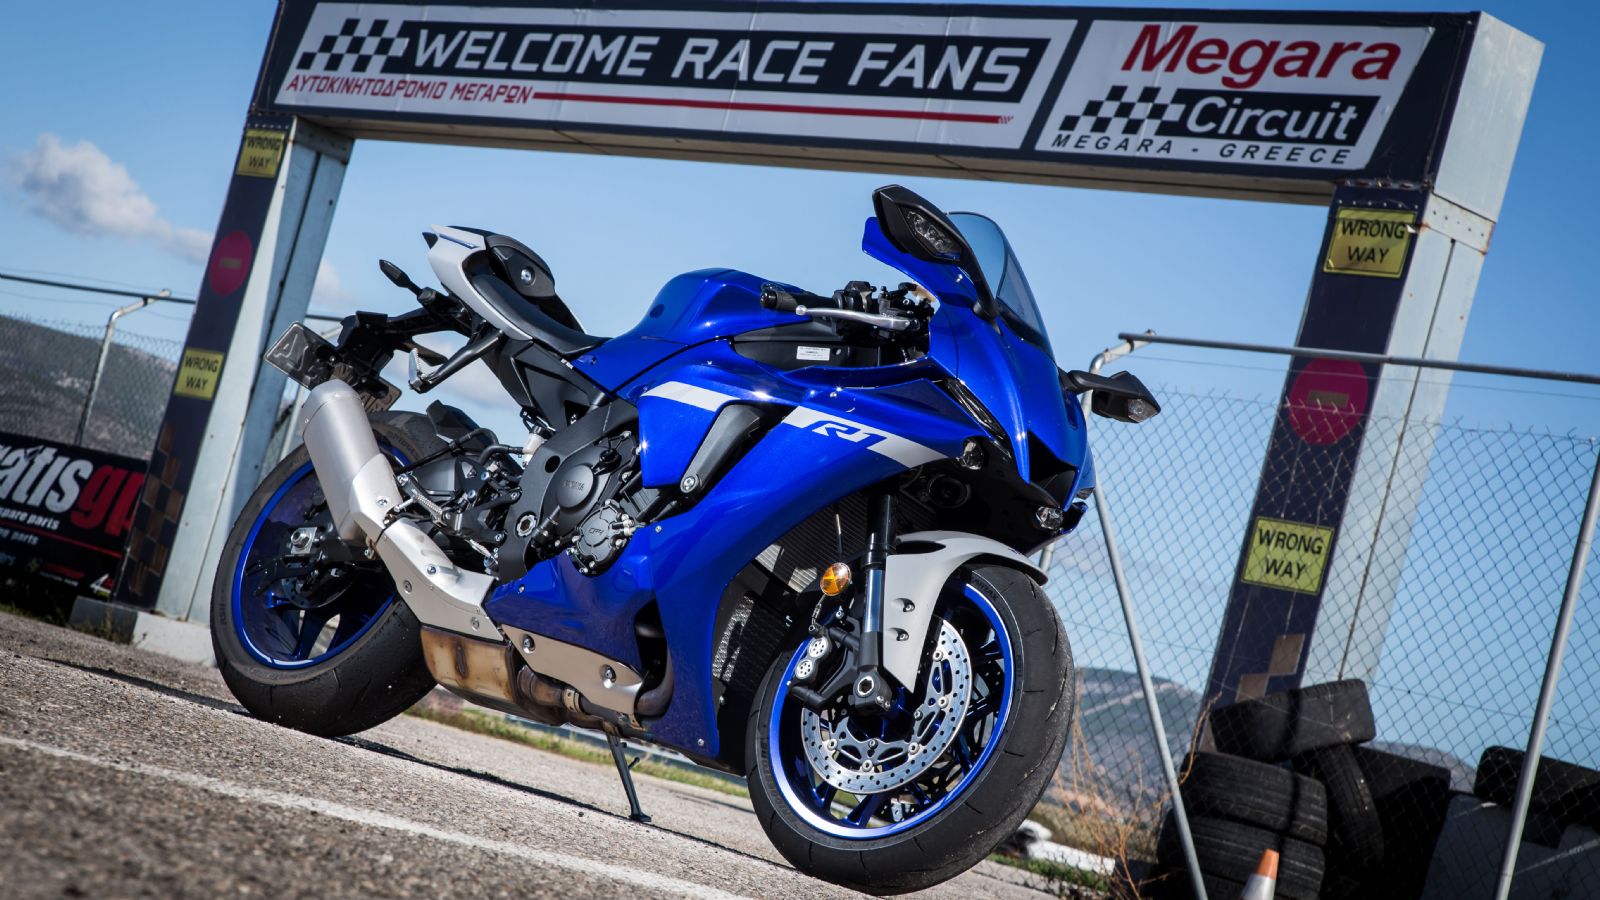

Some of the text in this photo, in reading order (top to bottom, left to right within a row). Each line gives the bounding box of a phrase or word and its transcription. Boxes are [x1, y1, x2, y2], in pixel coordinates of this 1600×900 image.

[414, 29, 1031, 93] WELCOME RACE FANS
[1120, 24, 1401, 89] Megara
[1186, 96, 1358, 140] Circuit
[1051, 133, 1173, 155] MEGARA
[1219, 142, 1351, 165] GREECE
[1341, 219, 1407, 239] WRONG
[1347, 246, 1390, 264] WAY
[184, 355, 219, 373] WRONG
[185, 375, 209, 391] WAY
[26, 514, 60, 530] parts
[1258, 528, 1324, 555] WRONG
[1265, 558, 1307, 580] WAY
